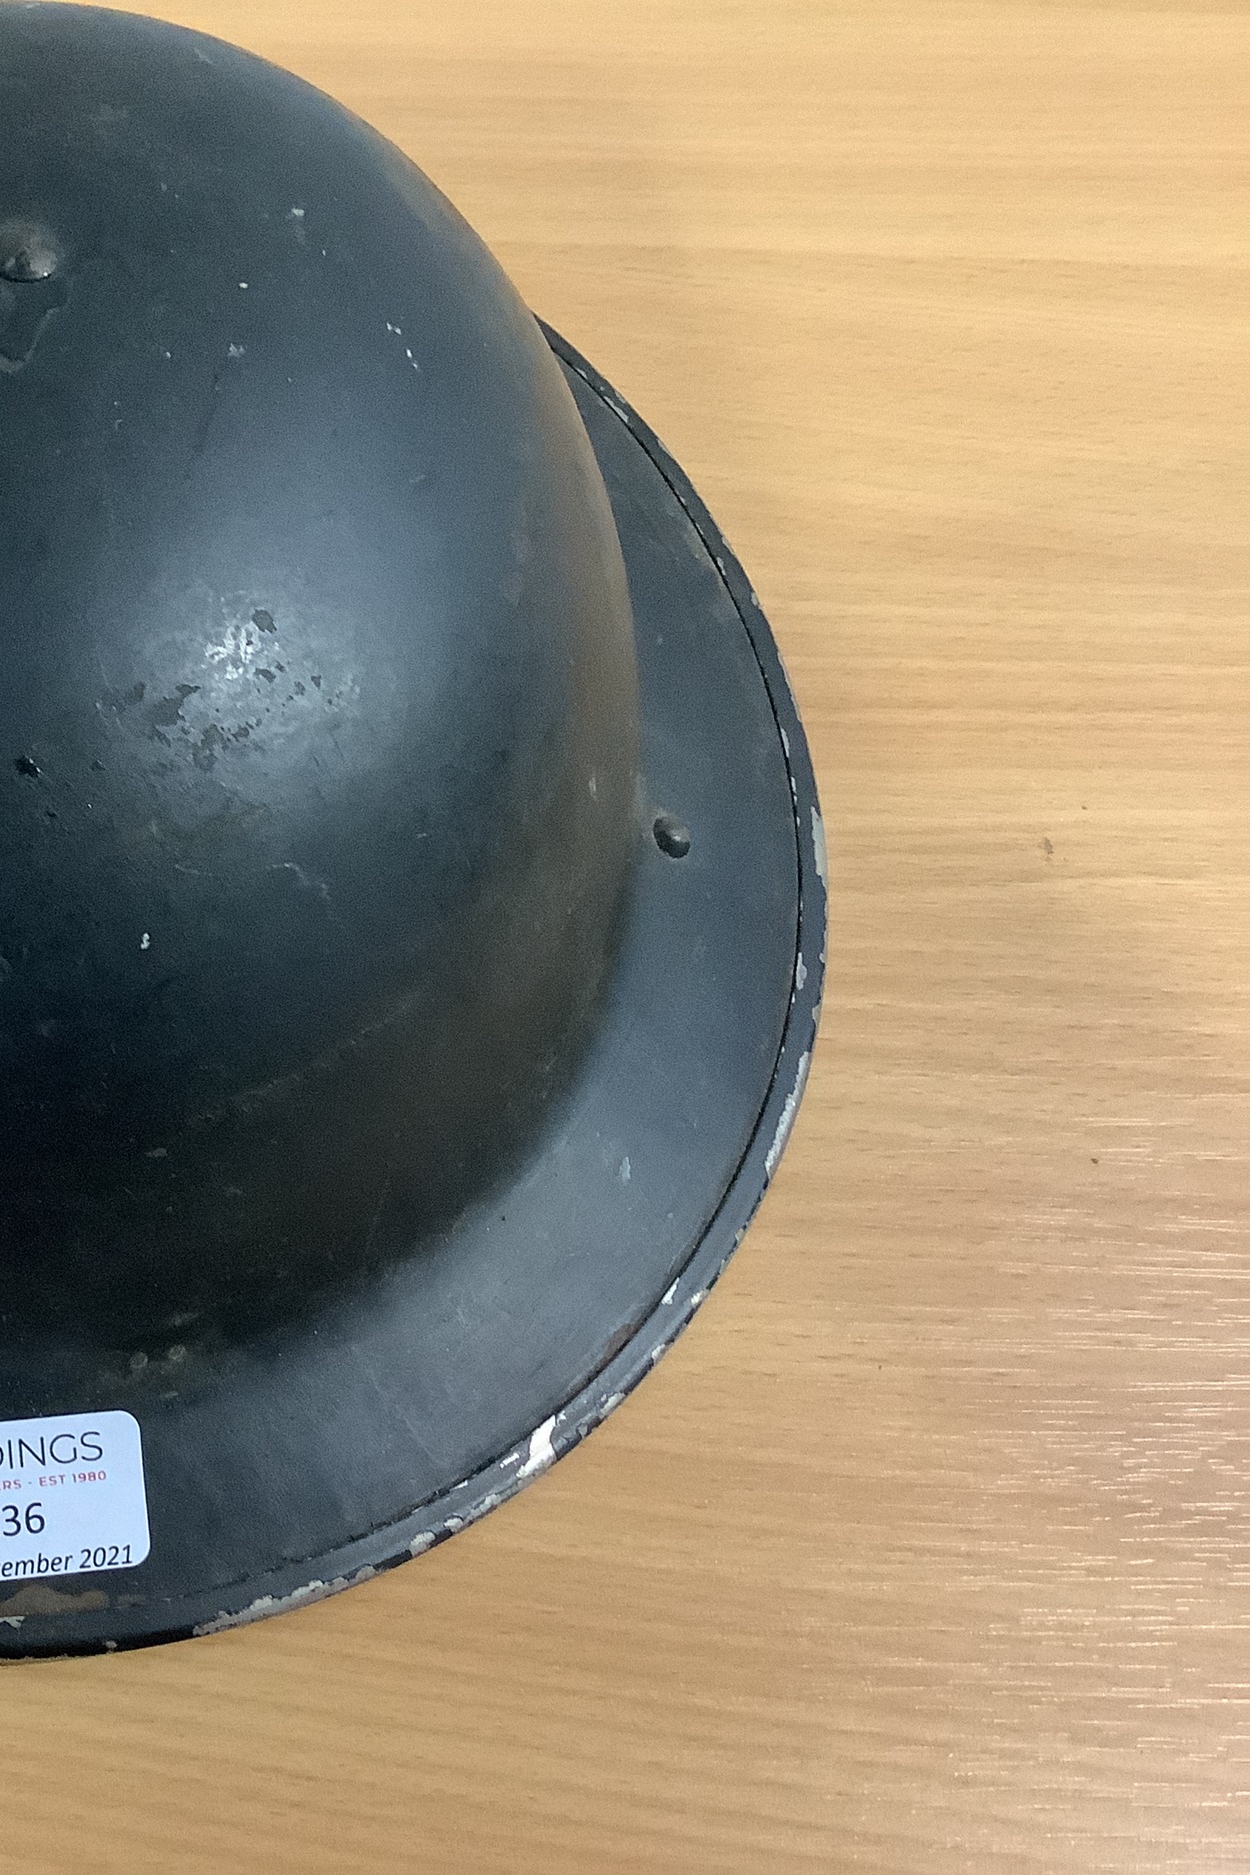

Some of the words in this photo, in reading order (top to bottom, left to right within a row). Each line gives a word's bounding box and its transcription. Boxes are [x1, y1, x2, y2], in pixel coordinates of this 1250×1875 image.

[39, 1474, 66, 1487] EST
[72, 1470, 107, 1483] 1980
[79, 1544, 133, 1568] 2021
